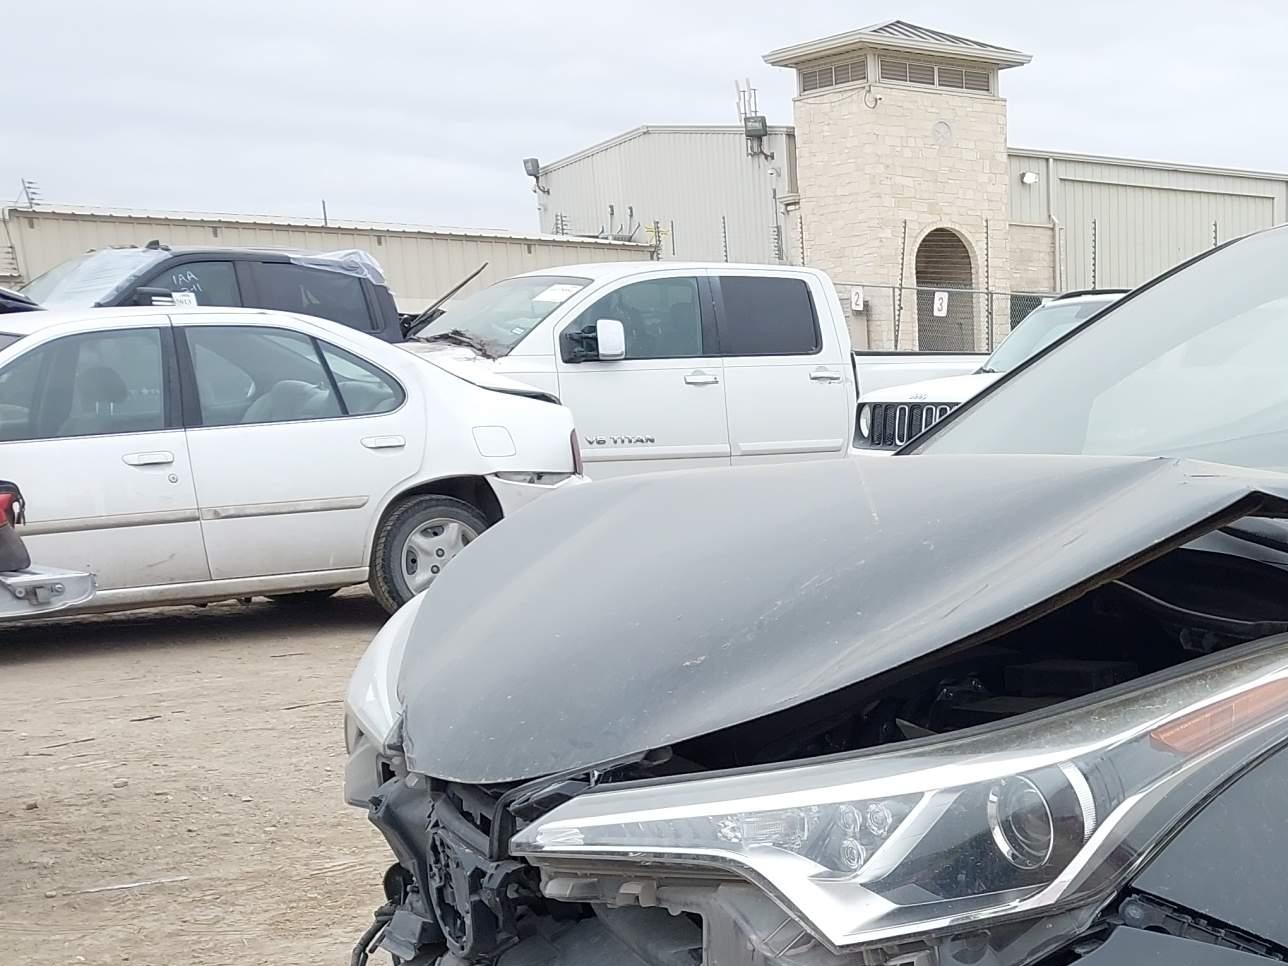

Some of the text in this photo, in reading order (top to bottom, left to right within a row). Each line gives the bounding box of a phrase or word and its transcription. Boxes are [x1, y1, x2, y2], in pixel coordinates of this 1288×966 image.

[854, 291, 860, 306] 2
[937, 297, 944, 312] 3
[584, 434, 655, 445] V6 TITAN
